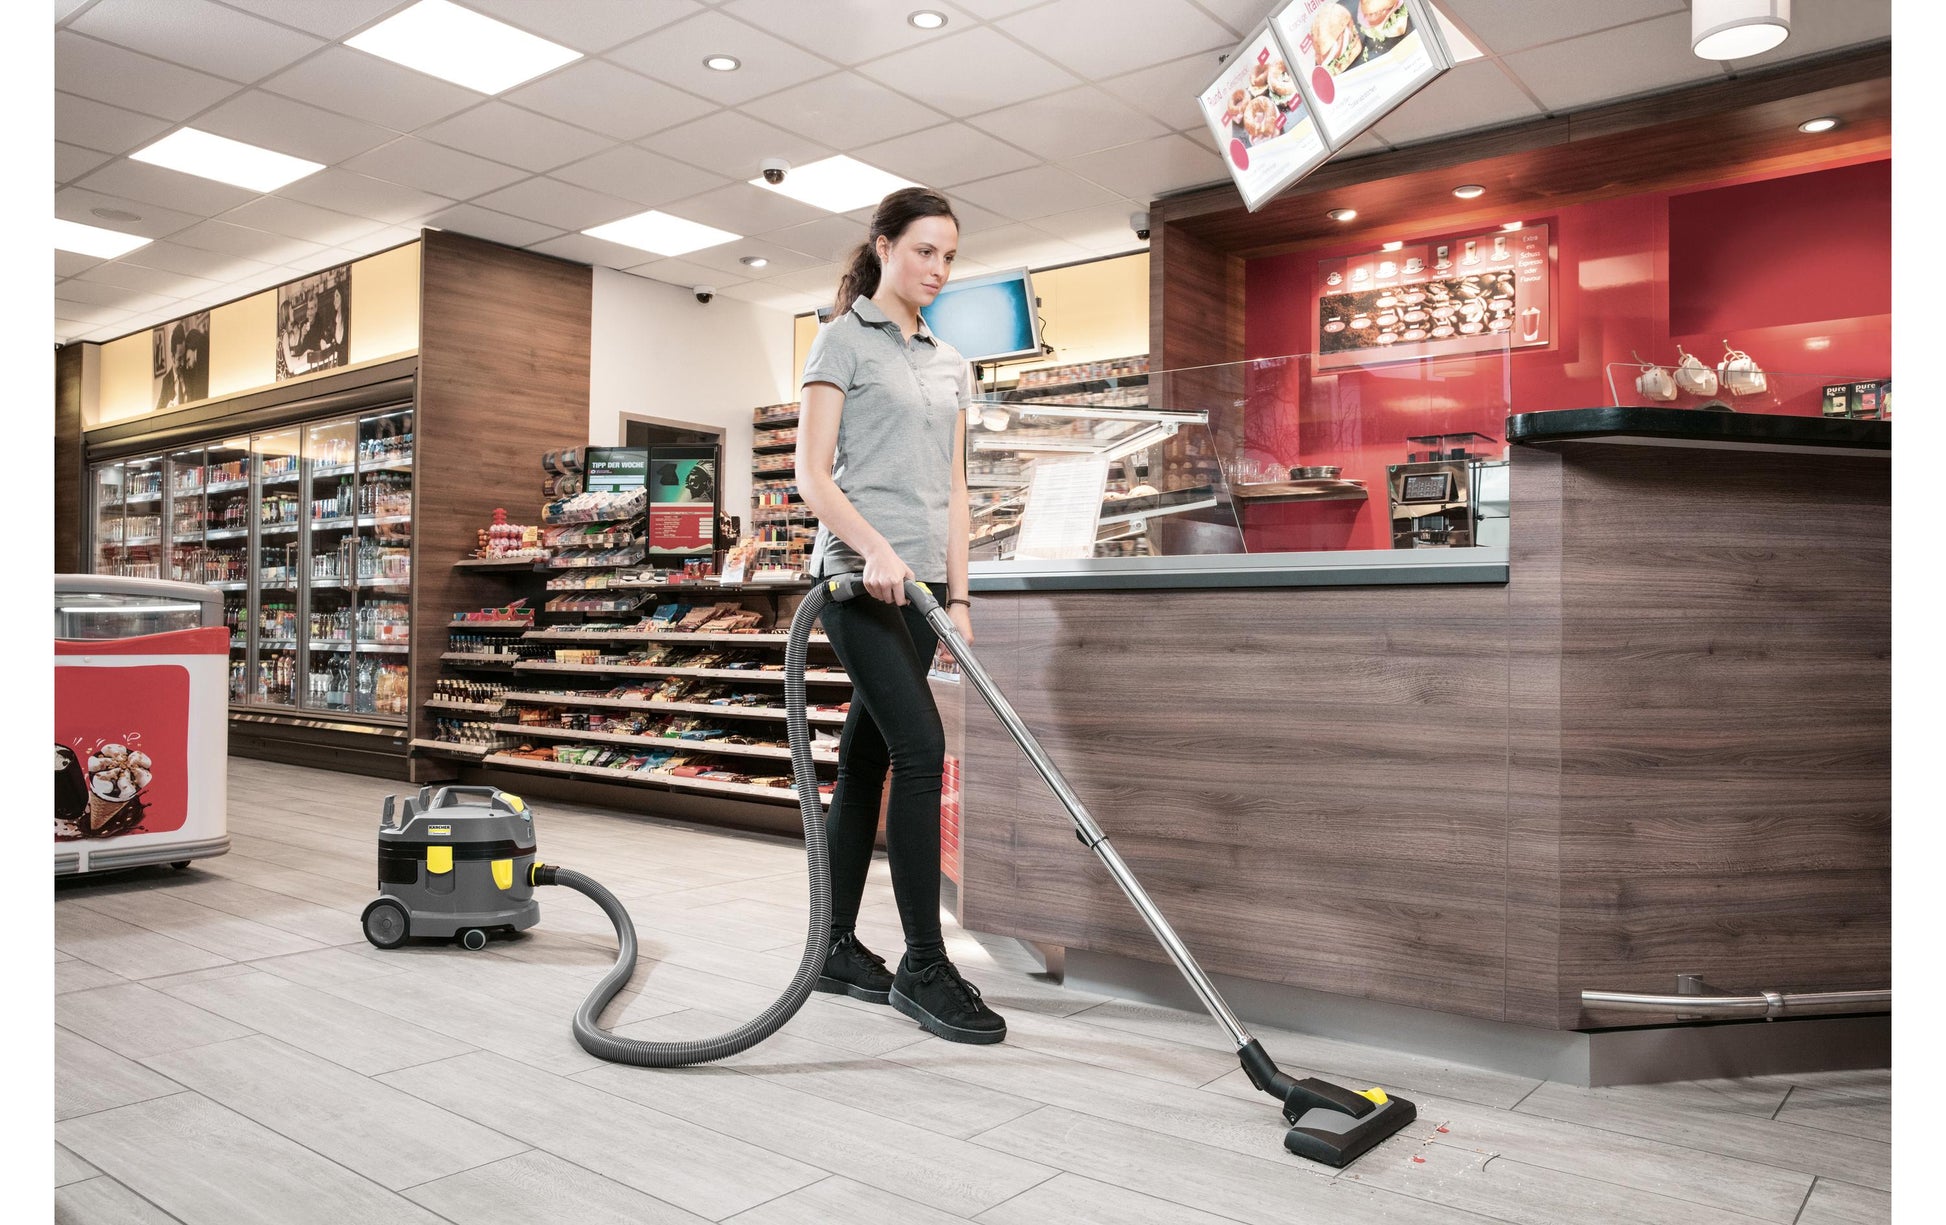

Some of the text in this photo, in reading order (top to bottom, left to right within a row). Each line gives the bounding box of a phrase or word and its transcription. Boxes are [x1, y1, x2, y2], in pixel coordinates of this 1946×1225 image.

[1518, 259, 1543, 267] Espresso
[1826, 386, 1846, 396] pure
[1855, 383, 1876, 393] pure
